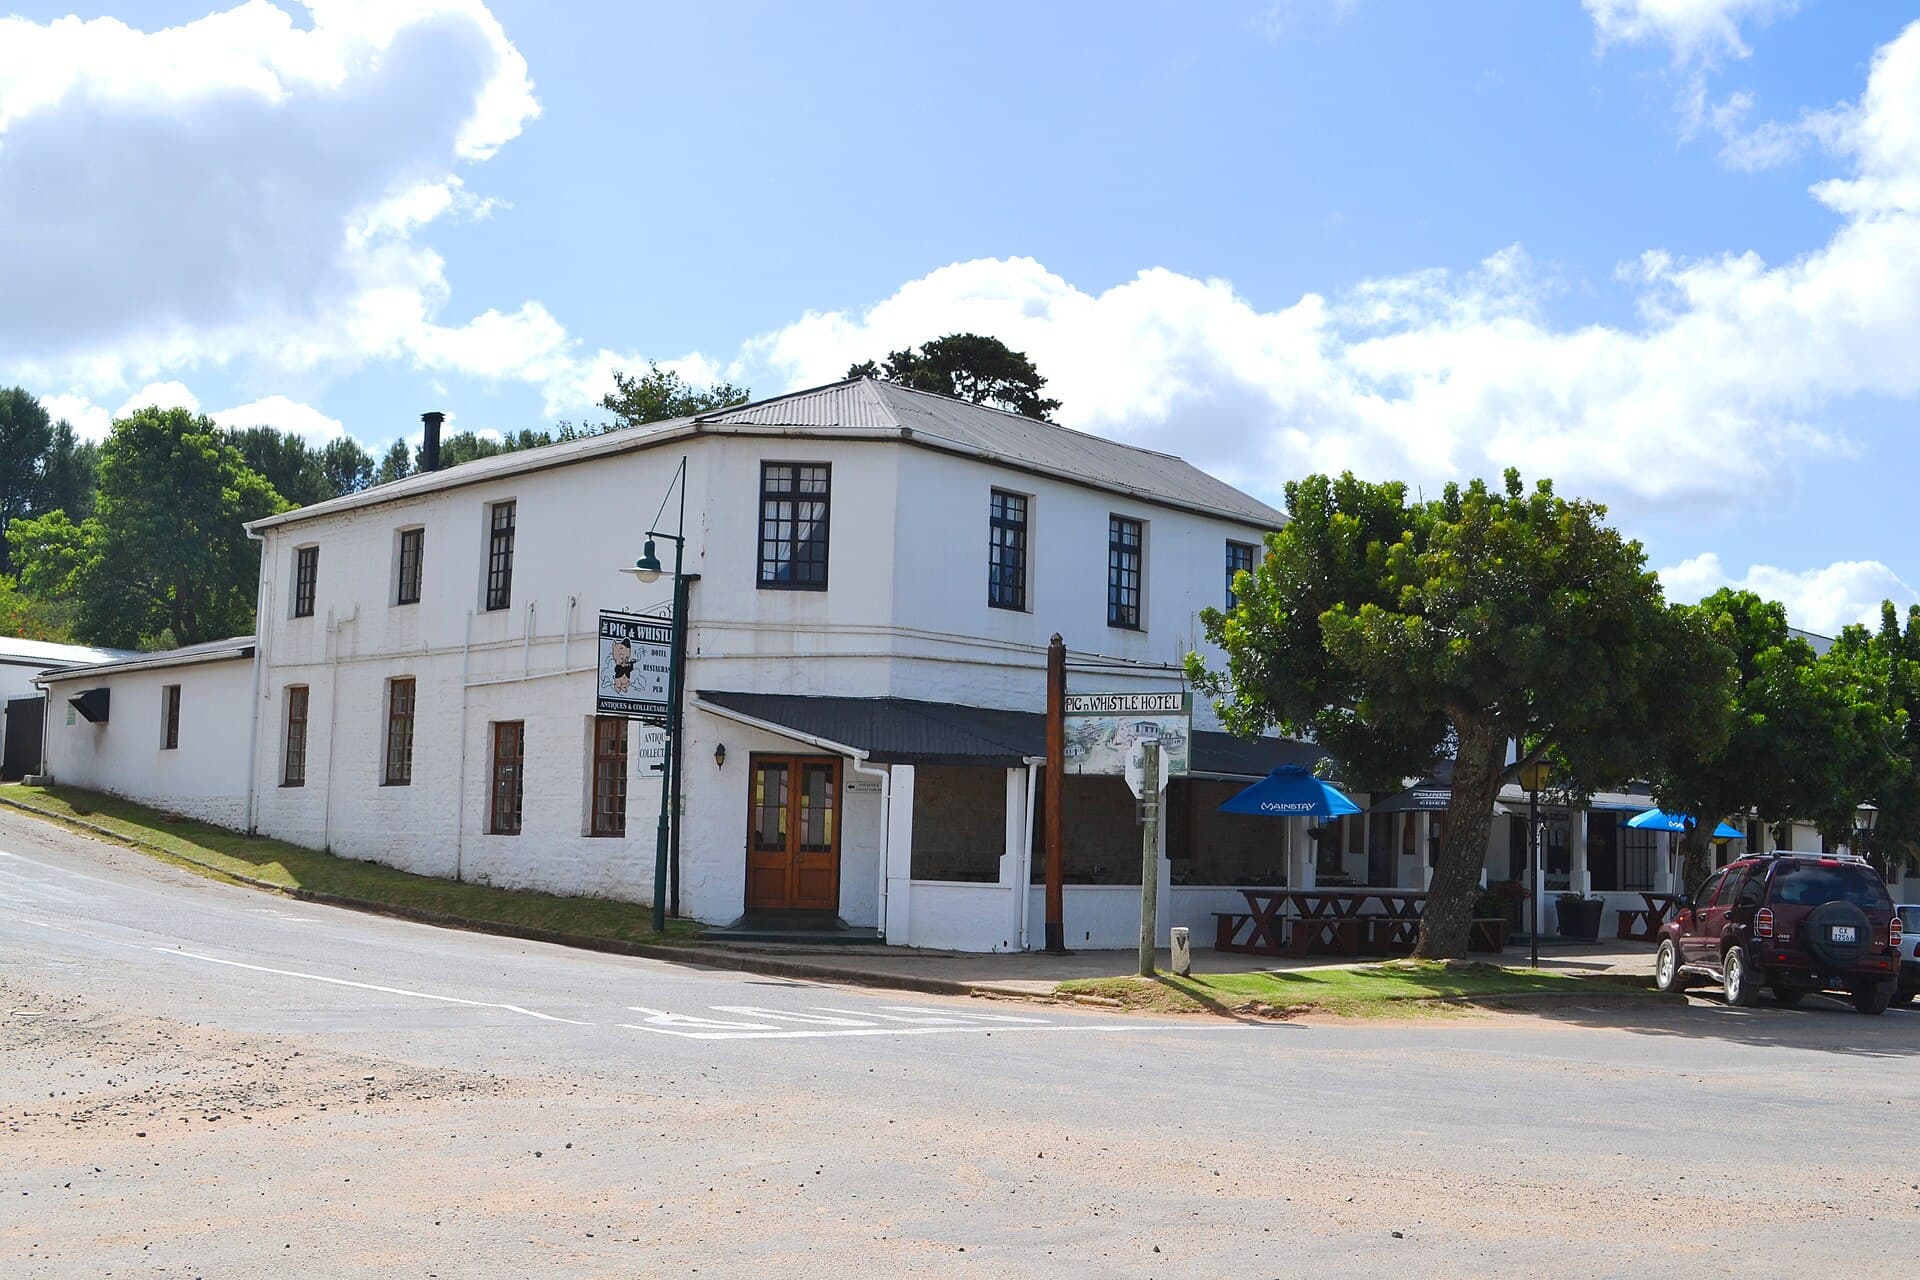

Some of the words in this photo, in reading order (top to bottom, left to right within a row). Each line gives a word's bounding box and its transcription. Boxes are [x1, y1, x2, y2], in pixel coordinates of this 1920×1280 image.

[609, 622, 627, 637] PIG
[628, 628, 635, 638] &
[651, 649, 667, 657] HOTEL
[652, 685, 663, 693] PUB
[600, 700, 627, 710] ANTIQUES
[1083, 703, 1090, 711] n
[1090, 695, 1139, 711] WHISTLE
[1141, 694, 1179, 710] HOTEL
[640, 748, 664, 758] COLLECT
[1260, 801, 1316, 811] MAINSTAY
